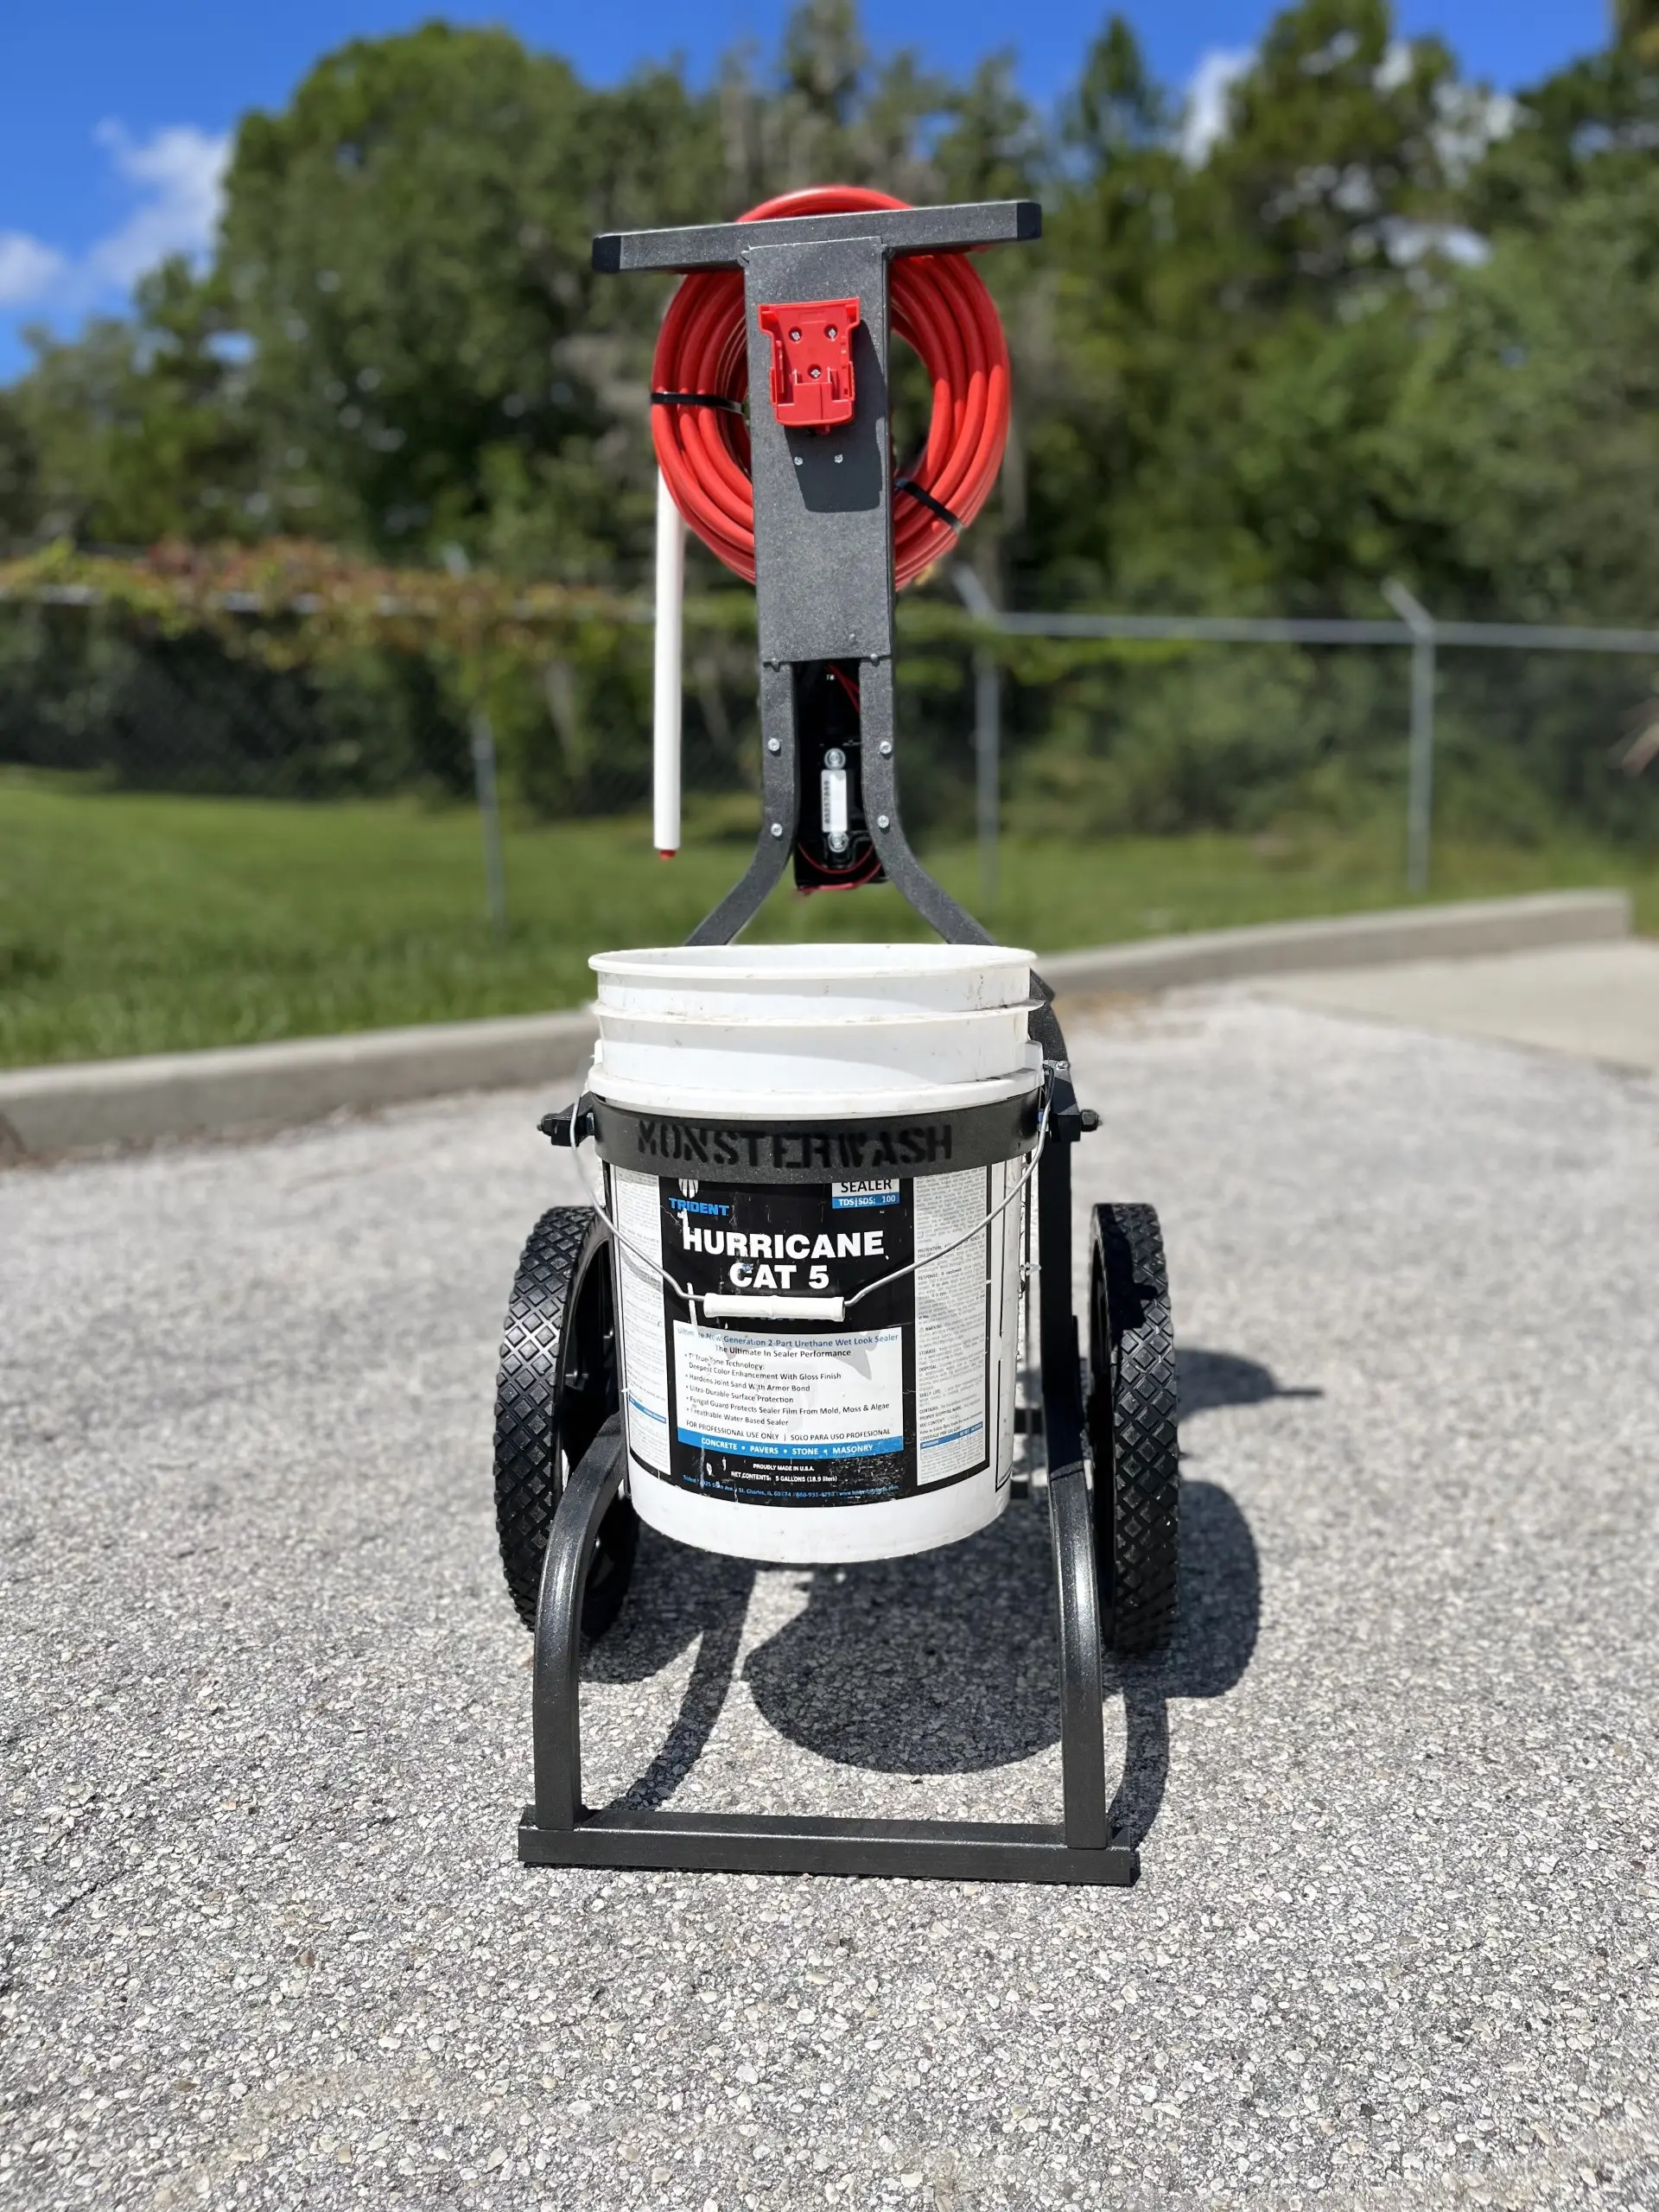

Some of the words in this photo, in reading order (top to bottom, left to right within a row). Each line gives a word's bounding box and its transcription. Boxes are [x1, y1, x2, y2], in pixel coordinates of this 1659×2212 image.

[638, 1120, 952, 1168] MONSTERWASH
[841, 1179, 892, 1192] SEALER
[668, 1198, 729, 1216] TRIDENT
[882, 1195, 896, 1204] 100
[683, 1227, 884, 1259] HURRICANE
[729, 1262, 797, 1289] CAT
[809, 1265, 830, 1289] 5
[677, 1327, 704, 1338] Ultimte
[724, 1336, 766, 1346] Generation
[854, 1337, 873, 1345] Look
[874, 1333, 899, 1343] Sealer
[715, 1344, 728, 1353] The
[729, 1346, 761, 1356] Ultimate
[689, 1363, 712, 1373] Deepest
[714, 1367, 730, 1376] Color
[732, 1370, 778, 1380] Enhancement
[689, 1373, 713, 1383] Hardens
[715, 1378, 729, 1387] Joint
[690, 1395, 709, 1406] Fungal
[709, 1401, 728, 1409] Guard
[730, 1404, 757, 1413] Protects
[870, 1402, 889, 1411] Algae
[731, 1392, 755, 1401] Surface
[723, 1414, 743, 1422] Water
[686, 1420, 697, 1428] FOR
[698, 1424, 744, 1437] PROFESSIONAL
[847, 1428, 890, 1439] PROFESIONAL
[701, 1437, 737, 1450] CONCRETE
[749, 1445, 779, 1454] PAVERS
[832, 1444, 873, 1454] MASONRY
